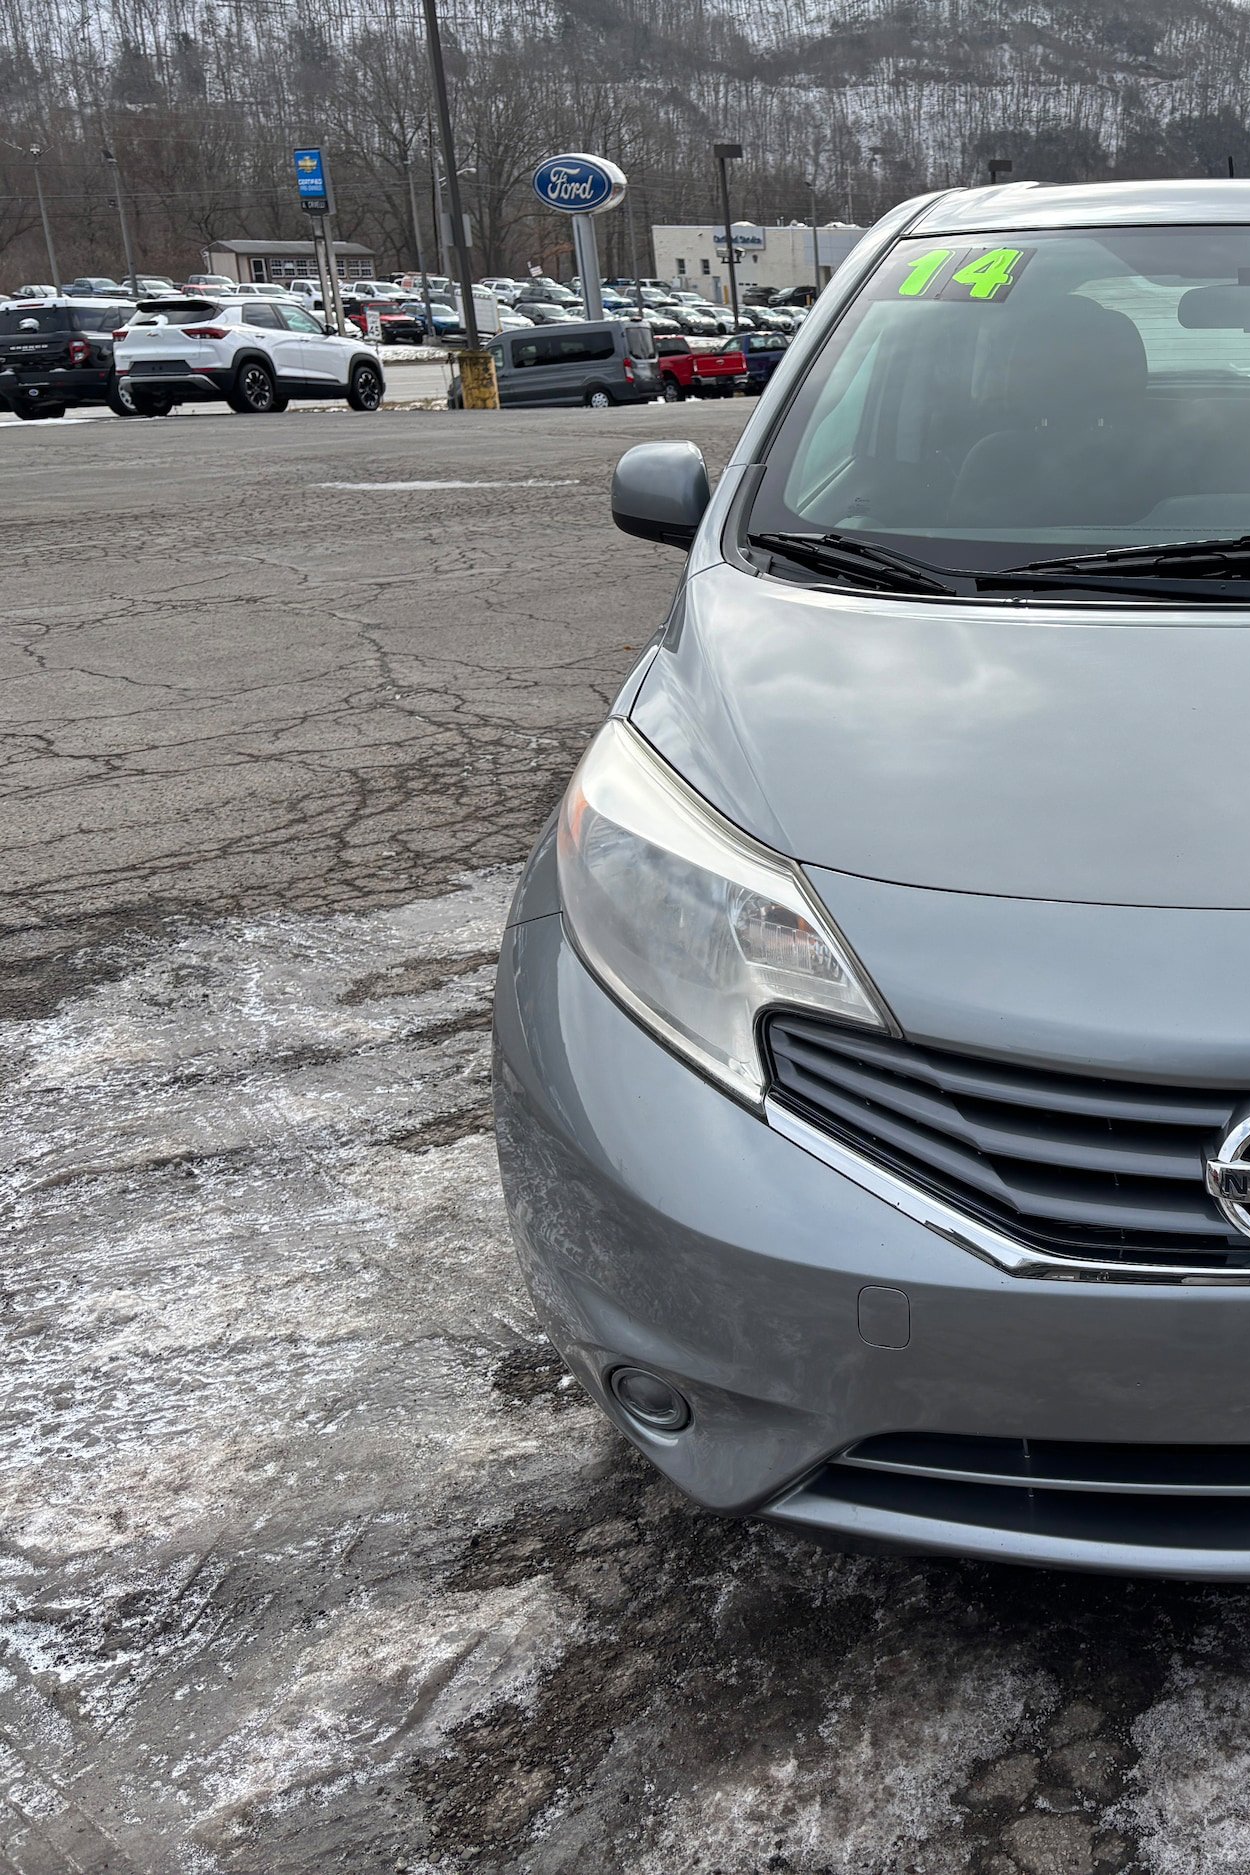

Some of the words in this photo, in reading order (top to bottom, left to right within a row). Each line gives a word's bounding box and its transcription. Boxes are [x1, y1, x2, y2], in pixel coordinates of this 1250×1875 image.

[547, 167, 593, 199] Ford
[899, 249, 1024, 299] 14
[369, 326, 380, 337] 45
